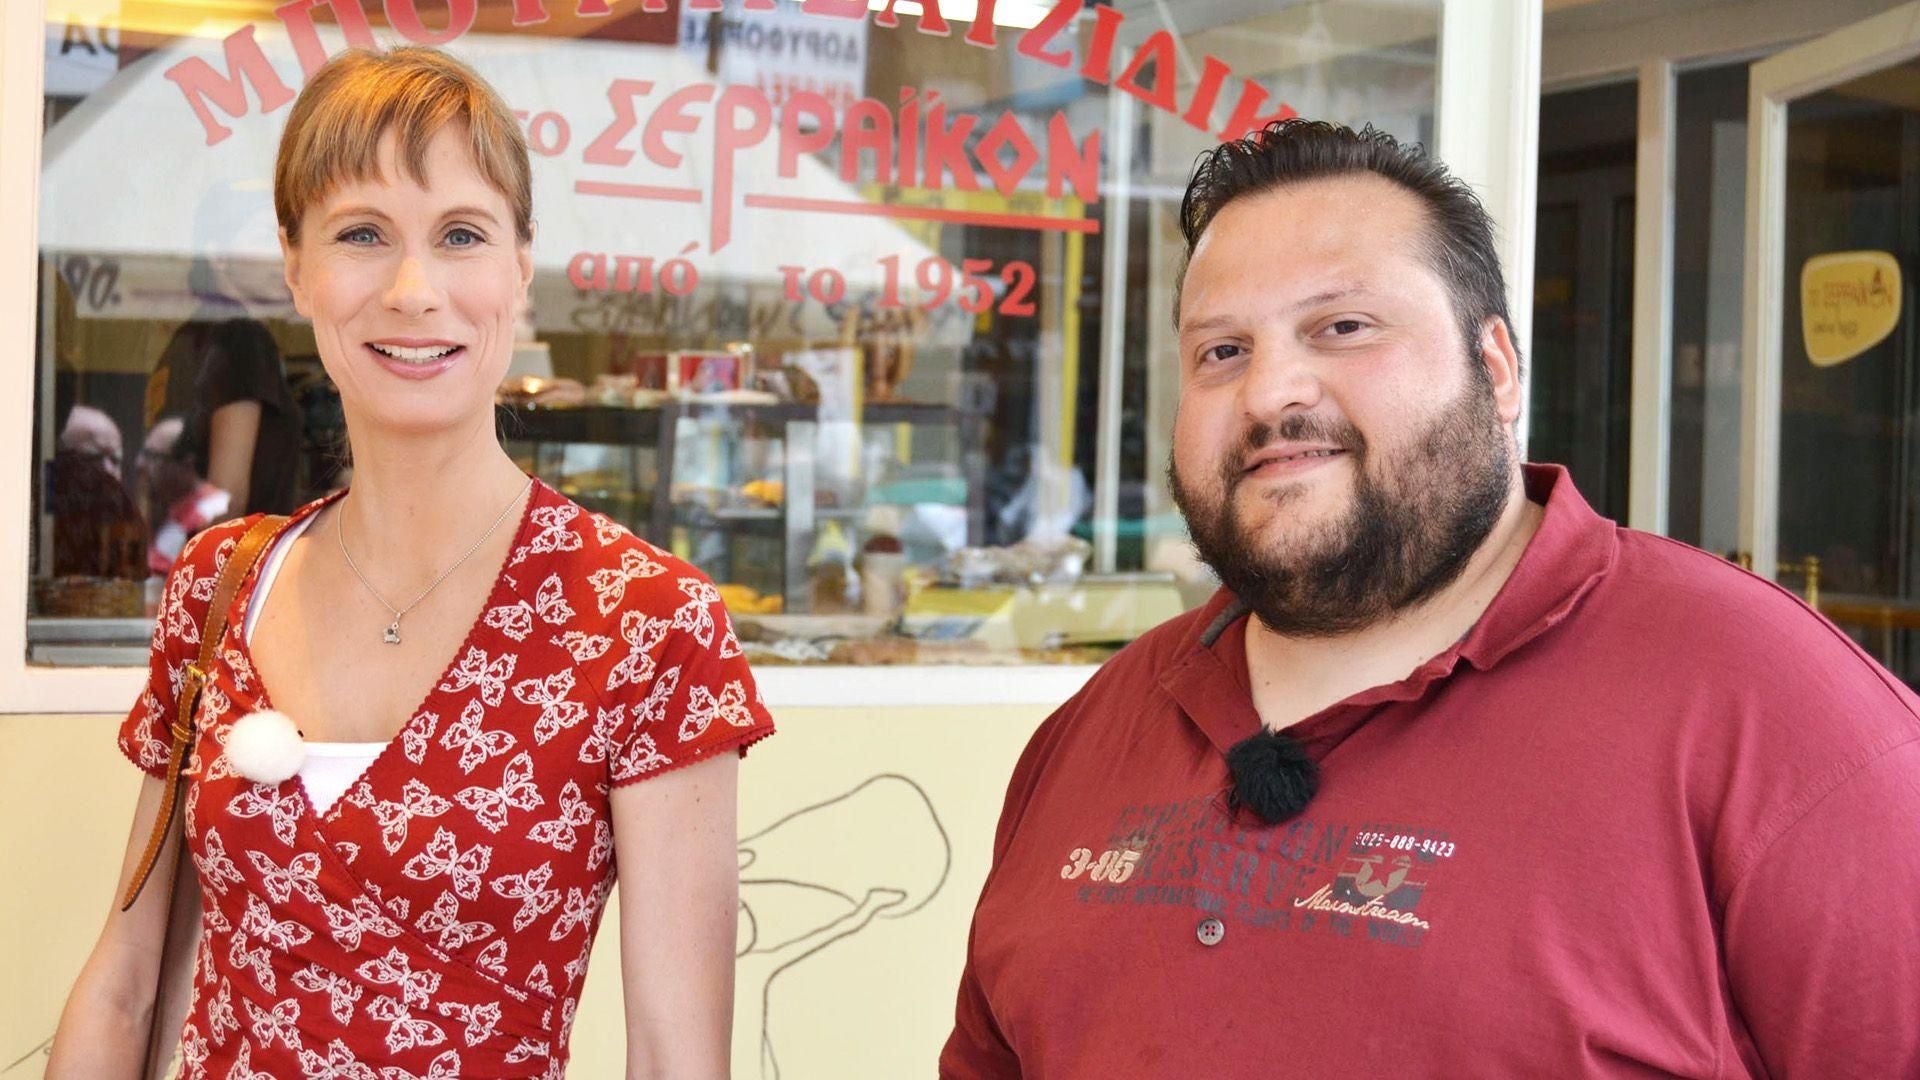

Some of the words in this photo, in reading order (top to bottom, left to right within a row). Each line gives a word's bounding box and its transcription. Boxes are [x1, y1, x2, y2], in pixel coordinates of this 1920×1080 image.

[566, 241, 700, 296] από
[778, 264, 847, 305] το
[877, 254, 1036, 318] 1952
[1294, 882, 1431, 930] Mainstream
